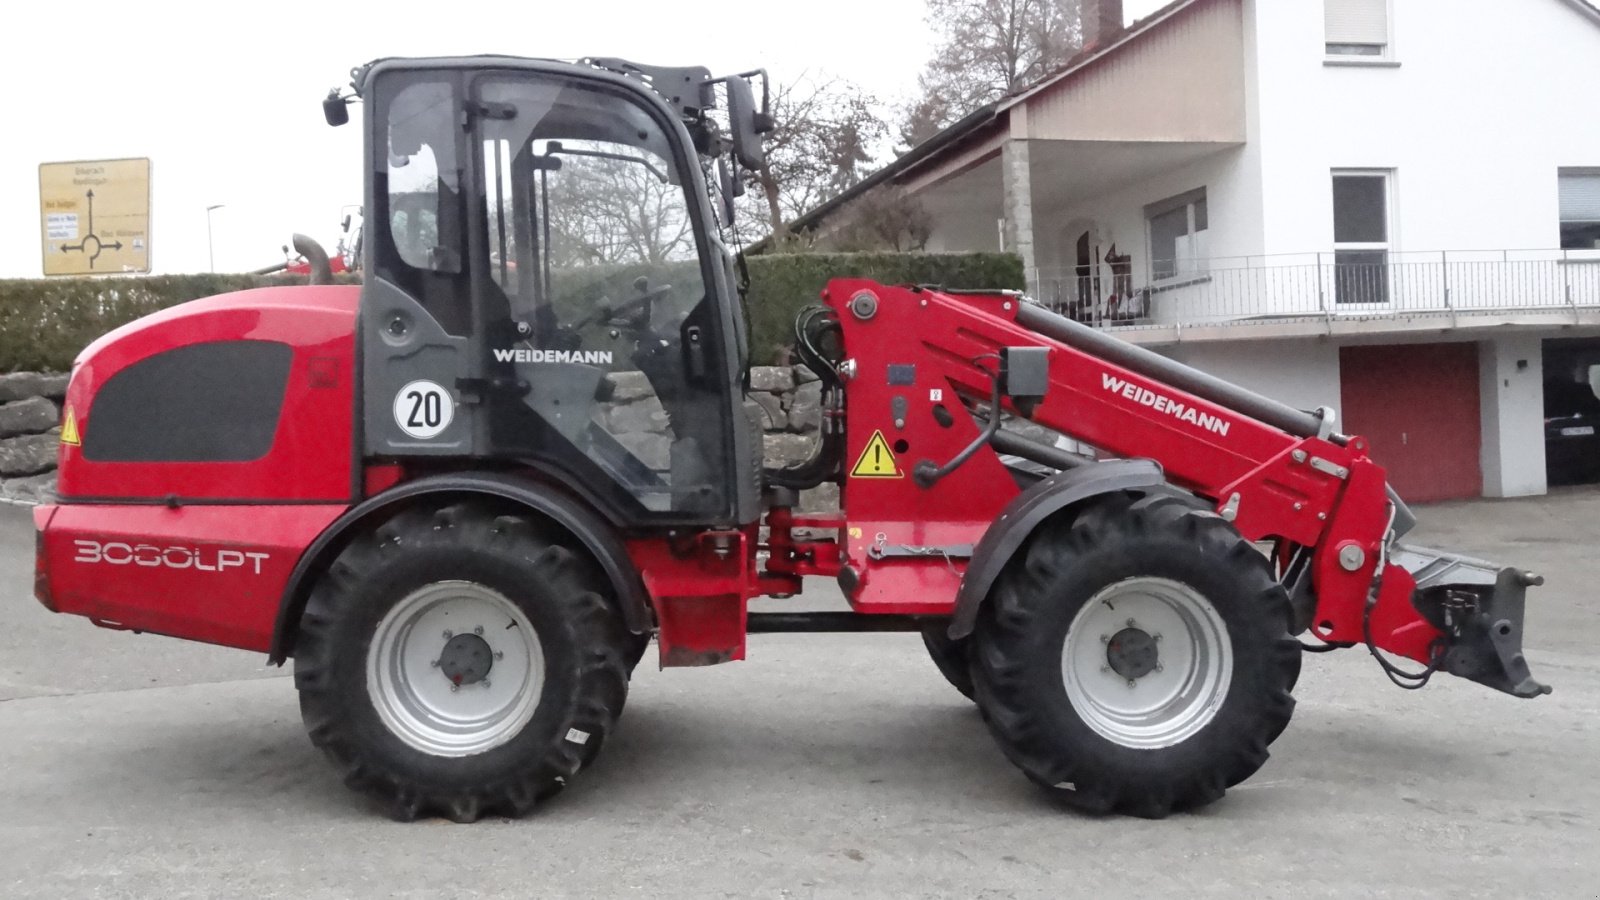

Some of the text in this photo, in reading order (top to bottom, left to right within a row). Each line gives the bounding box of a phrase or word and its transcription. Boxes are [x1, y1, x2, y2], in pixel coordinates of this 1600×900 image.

[493, 349, 613, 364] WEIDEMANN
[406, 390, 441, 428] 20
[1102, 373, 1231, 436] WEIDEMANN
